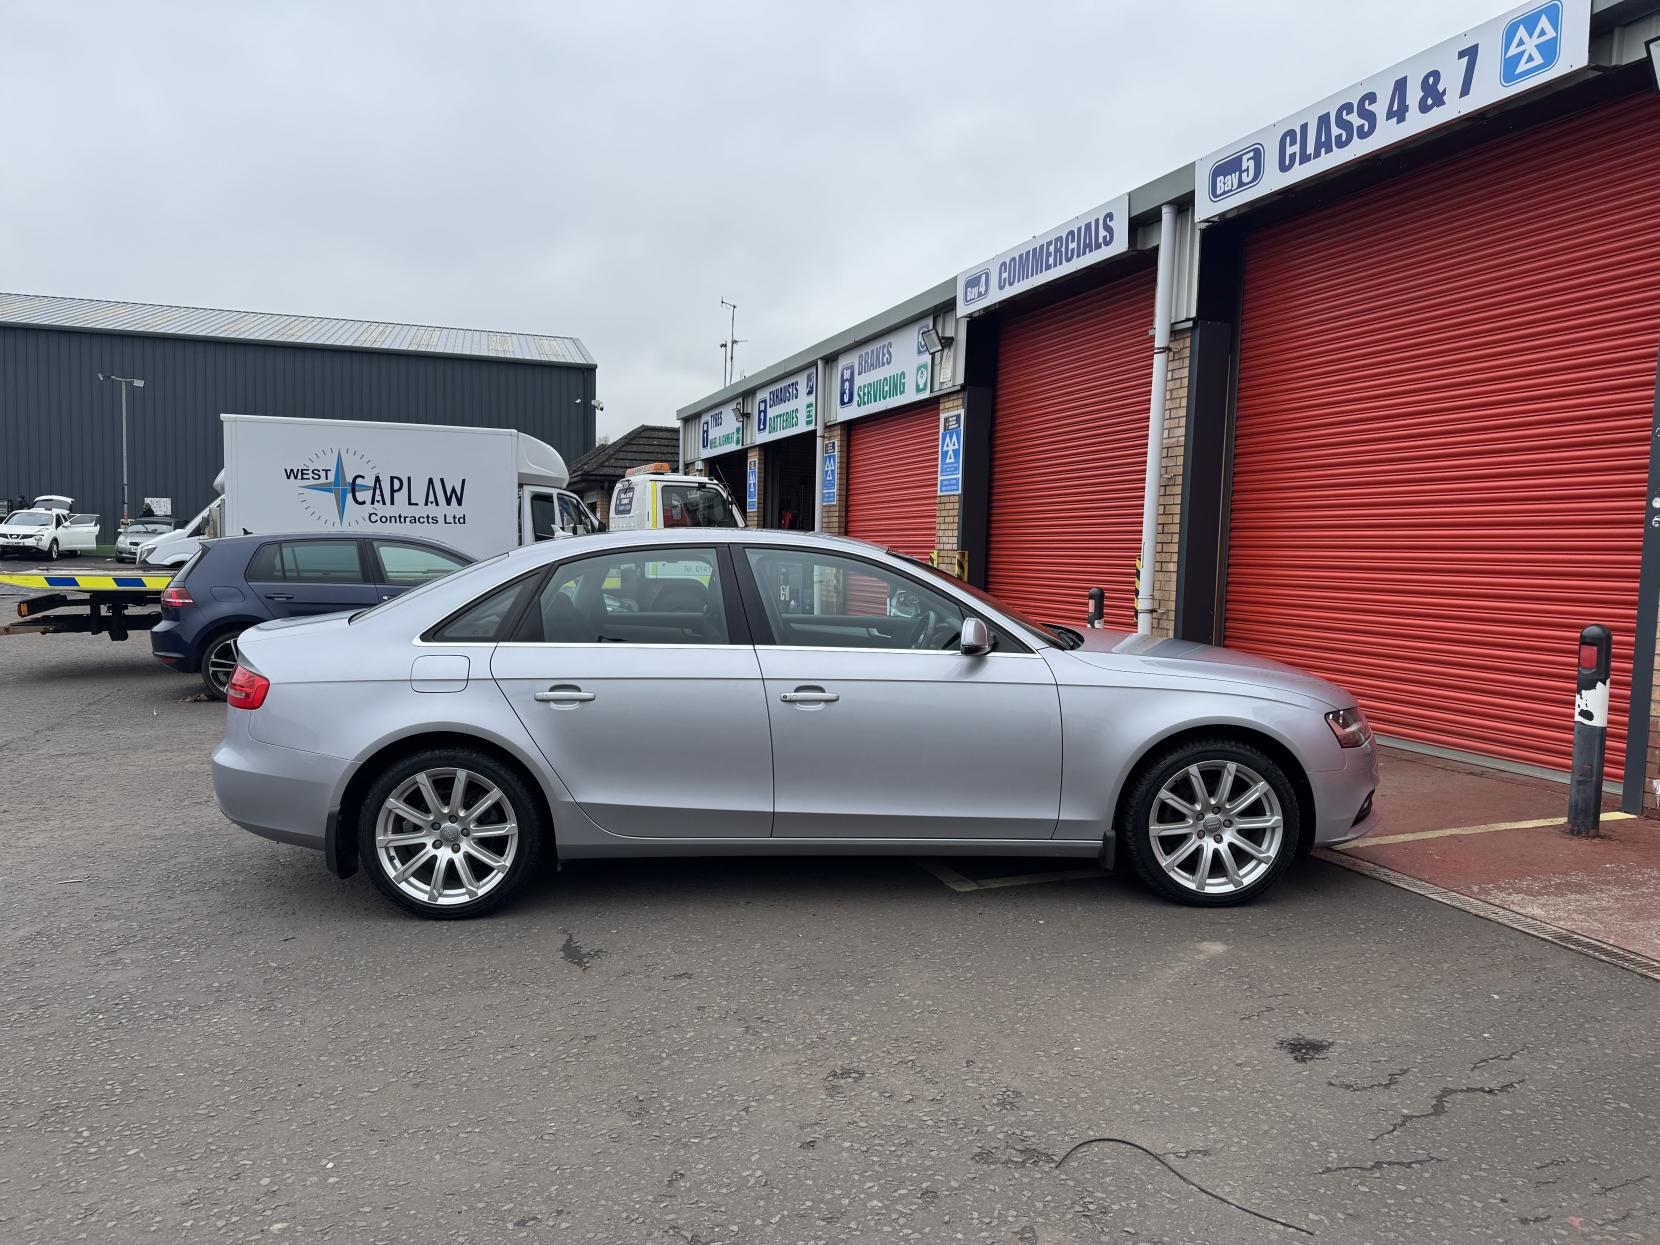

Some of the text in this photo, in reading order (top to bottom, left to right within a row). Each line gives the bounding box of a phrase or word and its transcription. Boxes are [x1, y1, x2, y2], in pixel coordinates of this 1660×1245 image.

[1278, 43, 1480, 173] CLASS 4 & 7
[1216, 151, 1255, 195] Bay 5
[997, 211, 1115, 291] COMMERCIALS
[979, 273, 986, 295] 4
[857, 341, 893, 376] BRAKES
[768, 380, 799, 409] EXHAUSTS
[843, 381, 850, 403] 3
[856, 371, 906, 407] SERVICING
[710, 410, 723, 430] TYRES
[759, 411, 765, 430] 2
[768, 408, 799, 434] BATTERIES
[703, 431, 708, 447] 1
[283, 468, 332, 481] WEST
[350, 474, 467, 507] CAPLAW
[367, 512, 467, 525] Contracts Ltd
